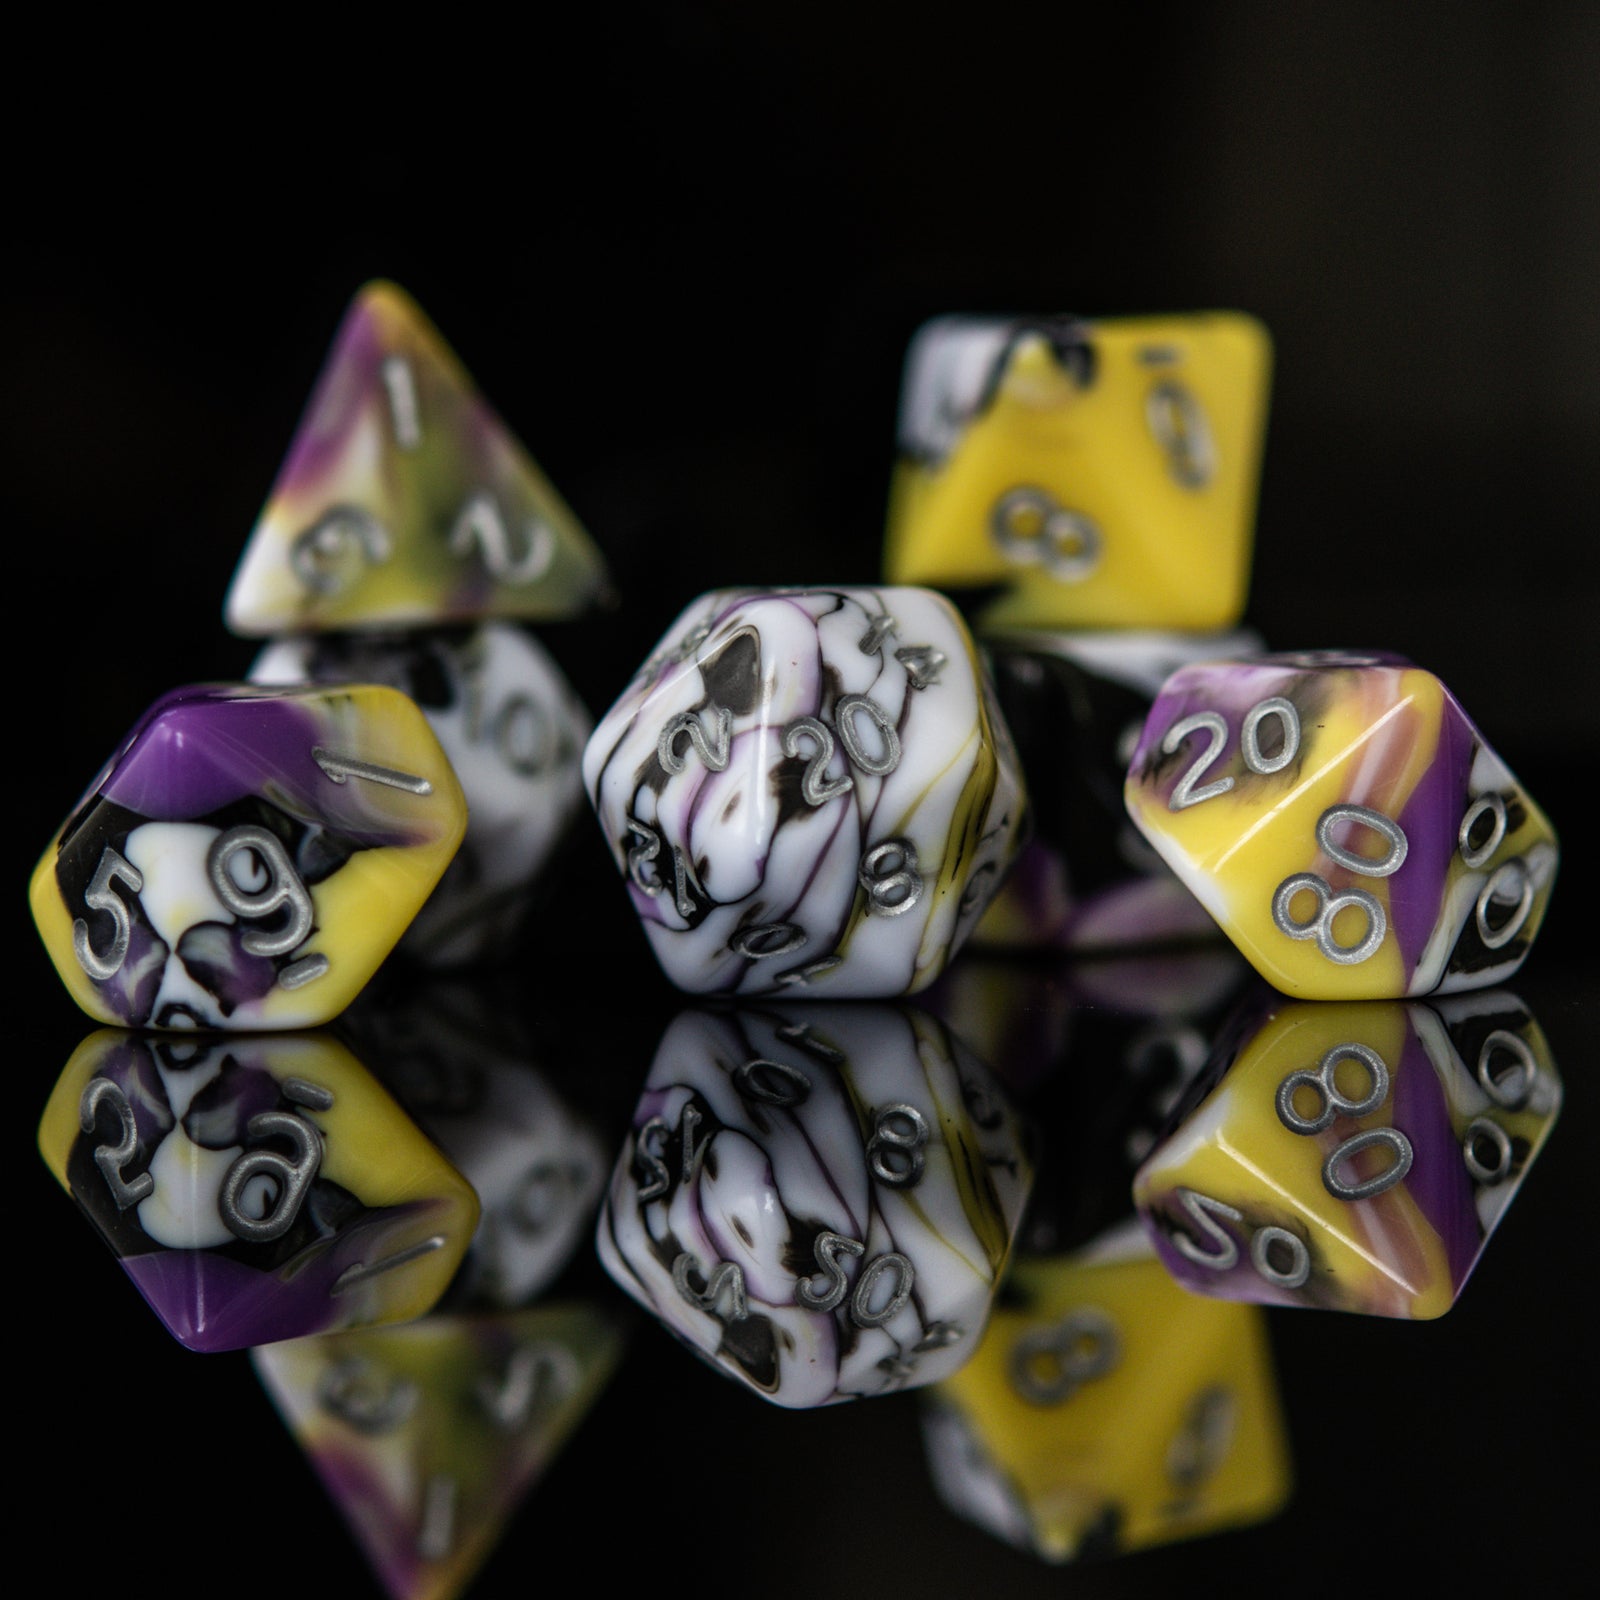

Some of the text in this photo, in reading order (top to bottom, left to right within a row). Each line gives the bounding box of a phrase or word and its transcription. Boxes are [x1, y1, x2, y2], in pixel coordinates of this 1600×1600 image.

[449, 493, 555, 582] 2
[989, 483, 1103, 585] 8
[657, 706, 733, 777] 2
[781, 693, 903, 807] 20
[1163, 697, 1300, 811] 20
[73, 846, 144, 981] 5
[206, 824, 314, 957] 9
[858, 836, 925, 917] 8
[1271, 803, 1409, 966] 80
[1458, 791, 1534, 950] 00
